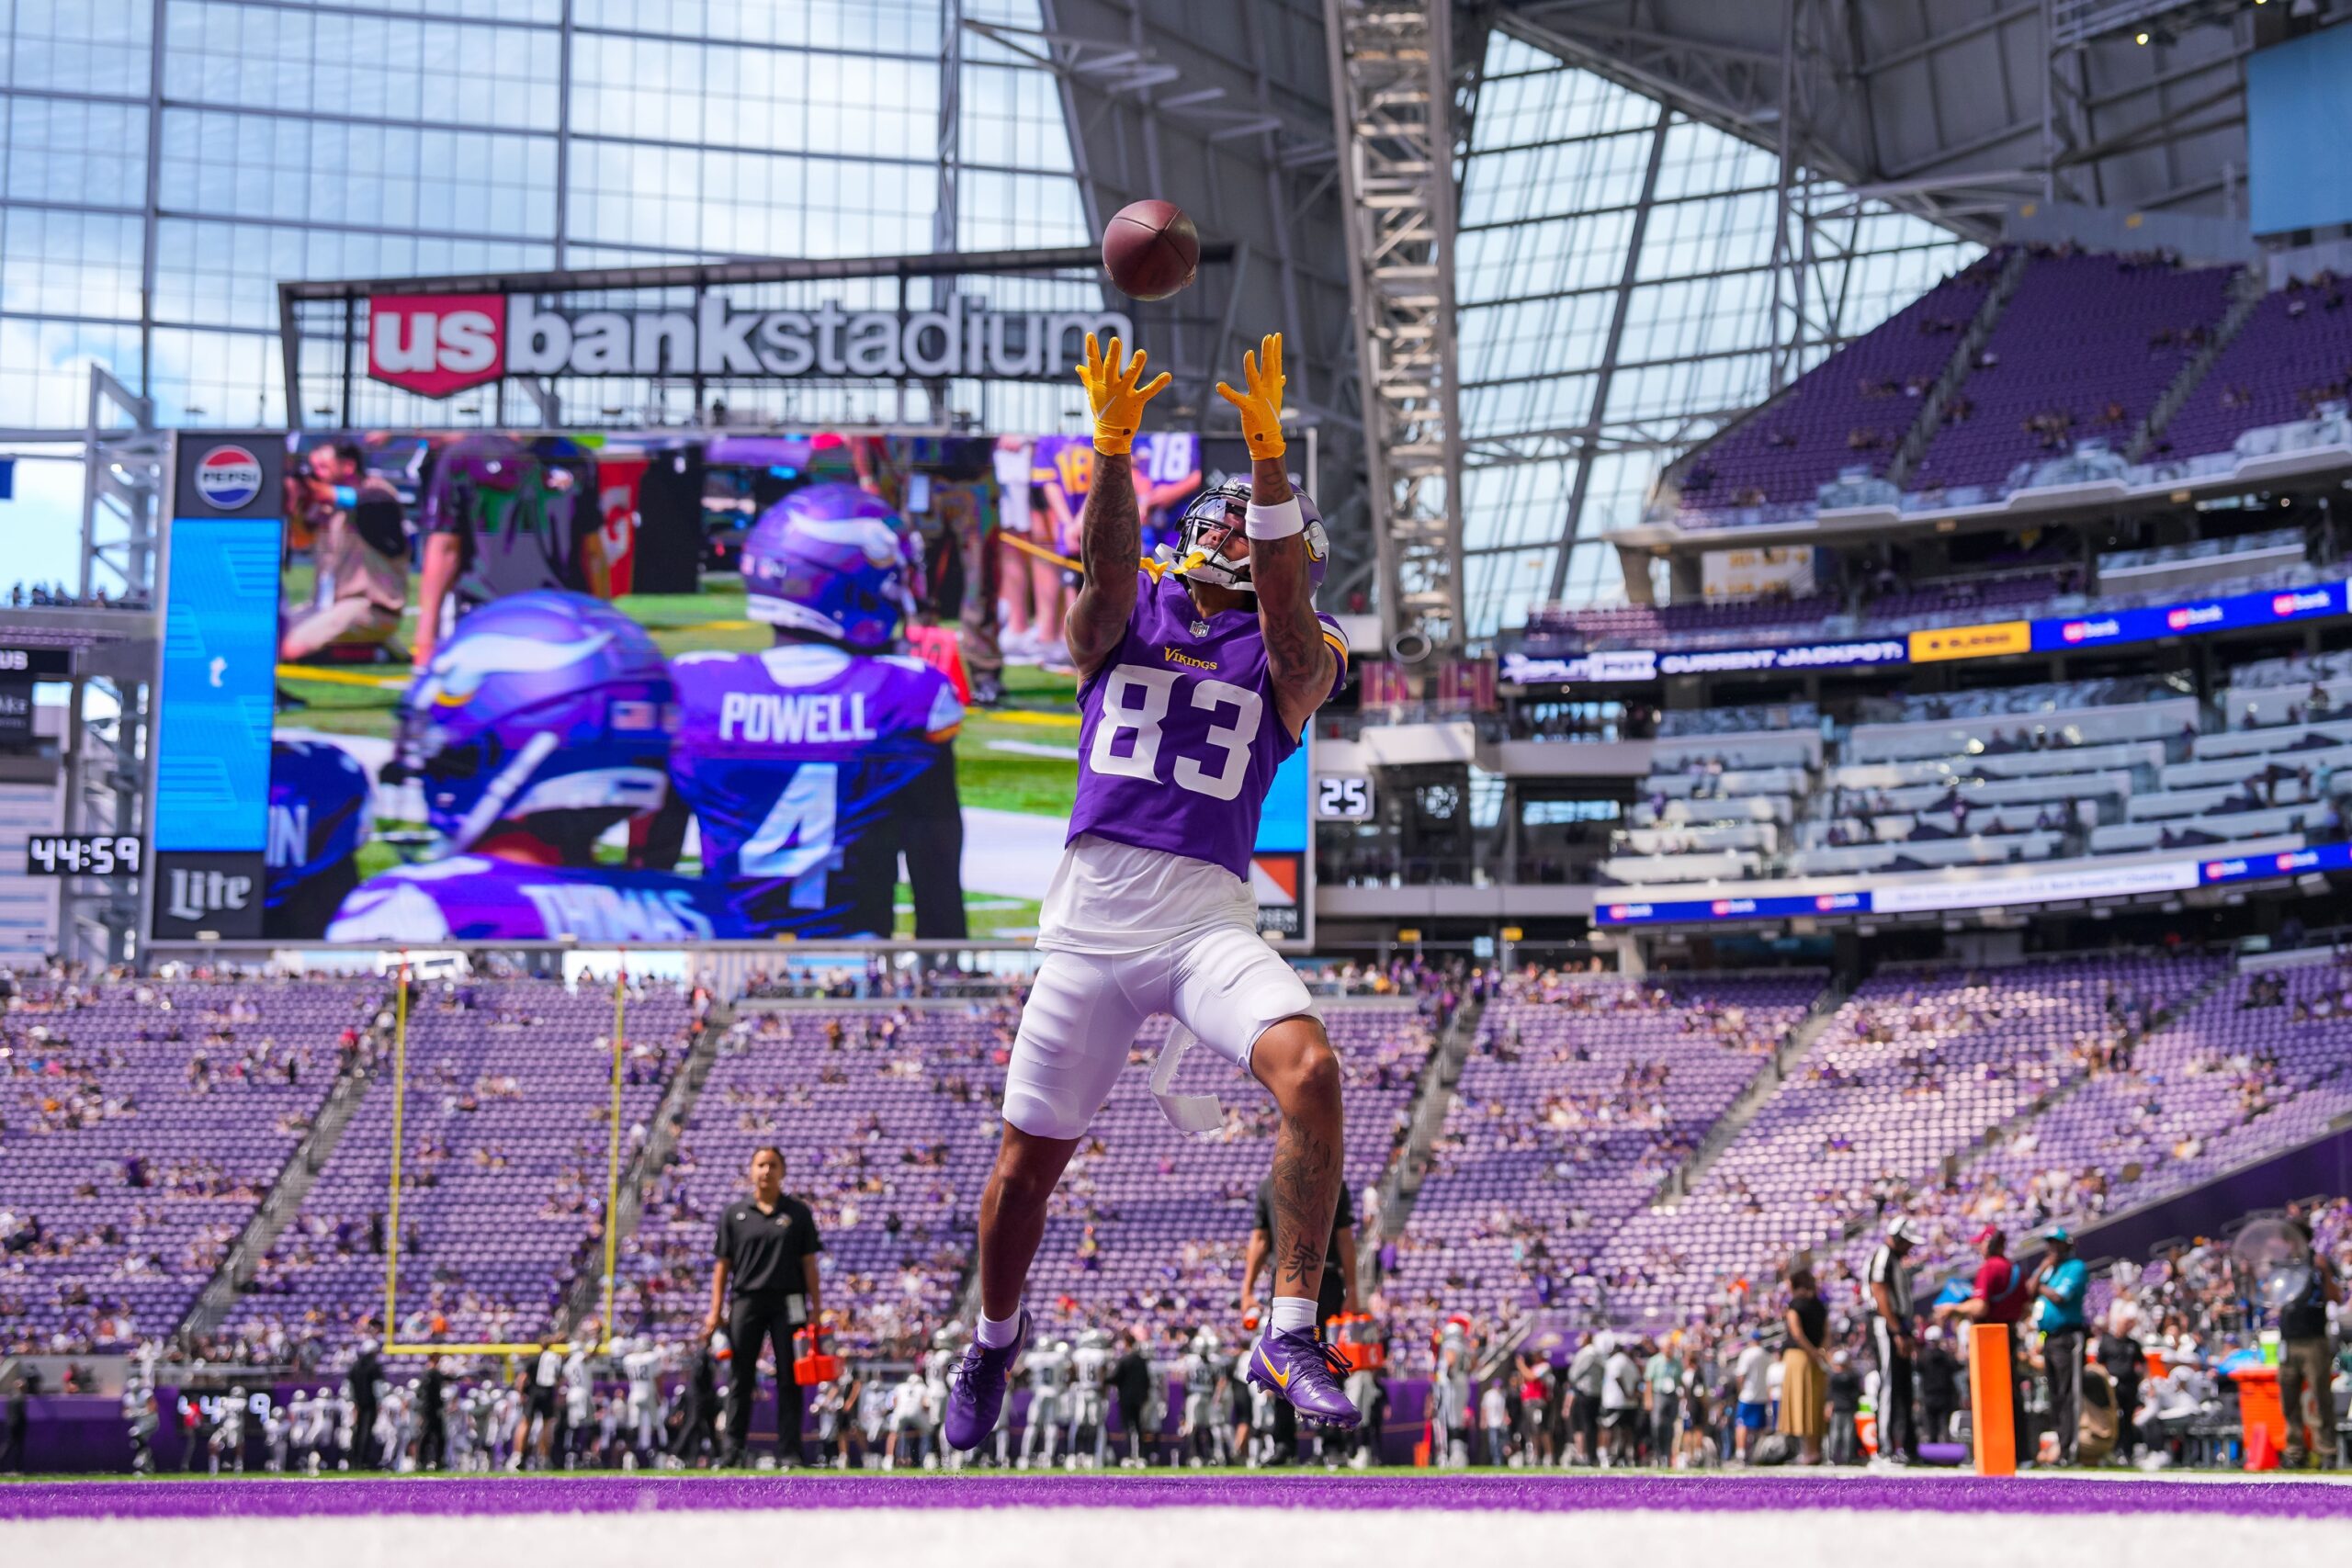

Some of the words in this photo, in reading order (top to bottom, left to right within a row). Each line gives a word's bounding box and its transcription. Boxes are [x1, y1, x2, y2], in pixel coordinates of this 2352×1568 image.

[1148, 433, 1193, 482] 18
[1660, 649, 1777, 674] CURRENT
[719, 691, 877, 743] POWELL
[1090, 663, 1263, 801] 83
[1319, 778, 1366, 816] 25
[30, 837, 141, 874] 44:59
[739, 761, 844, 909] 4
[169, 868, 252, 920] Lite
